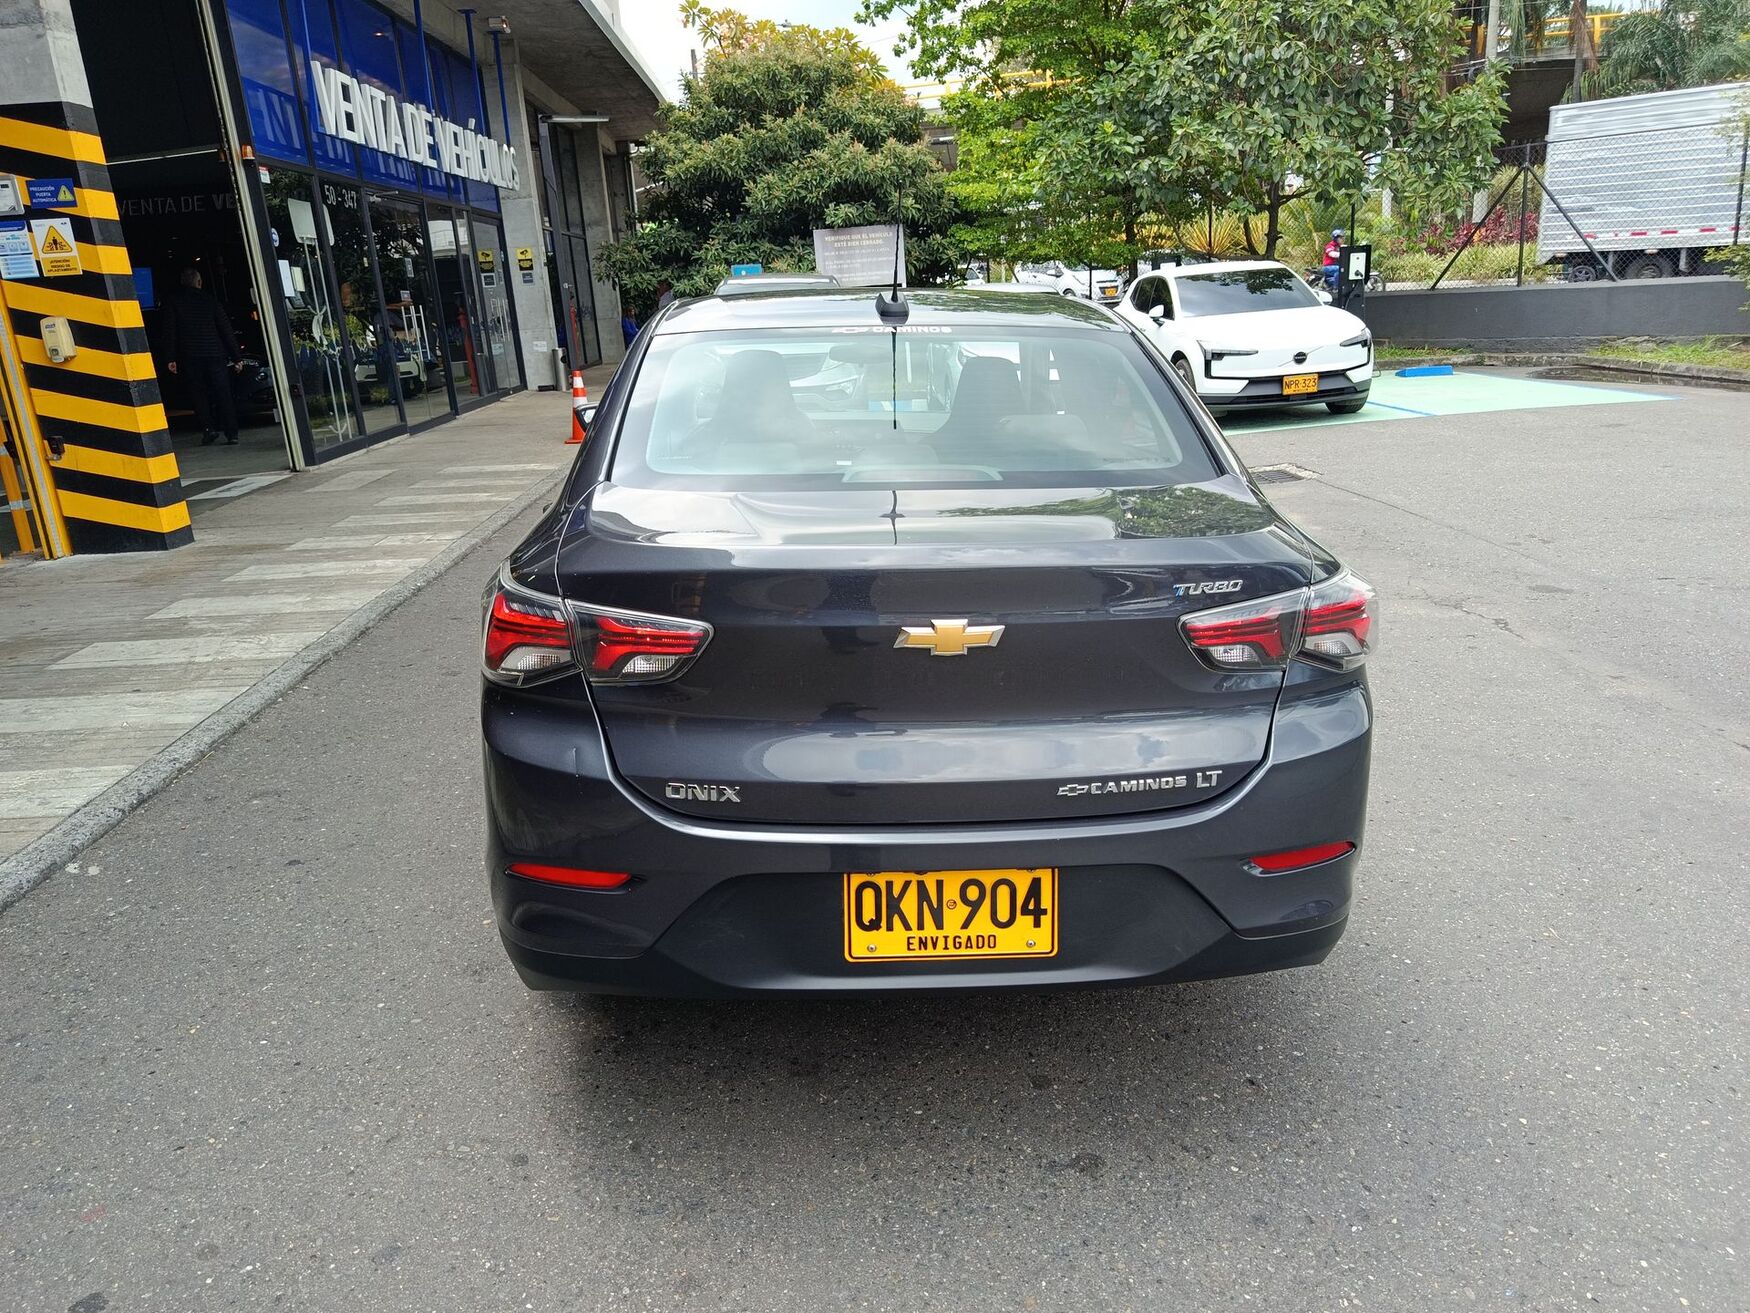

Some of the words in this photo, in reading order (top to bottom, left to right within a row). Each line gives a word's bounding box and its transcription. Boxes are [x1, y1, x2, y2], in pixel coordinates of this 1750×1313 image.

[311, 60, 408, 158] VENTA
[402, 103, 437, 168] DE
[435, 117, 520, 191] VEHÍCULOS
[181, 195, 205, 212] DE
[1173, 579, 1243, 597] TURBO
[665, 782, 741, 803] ONIX
[1090, 775, 1187, 795] CAMINOS
[1196, 770, 1223, 788] LT
[855, 879, 944, 932] QKN
[959, 877, 1048, 930] 904
[906, 934, 997, 951] ENVIGADO
